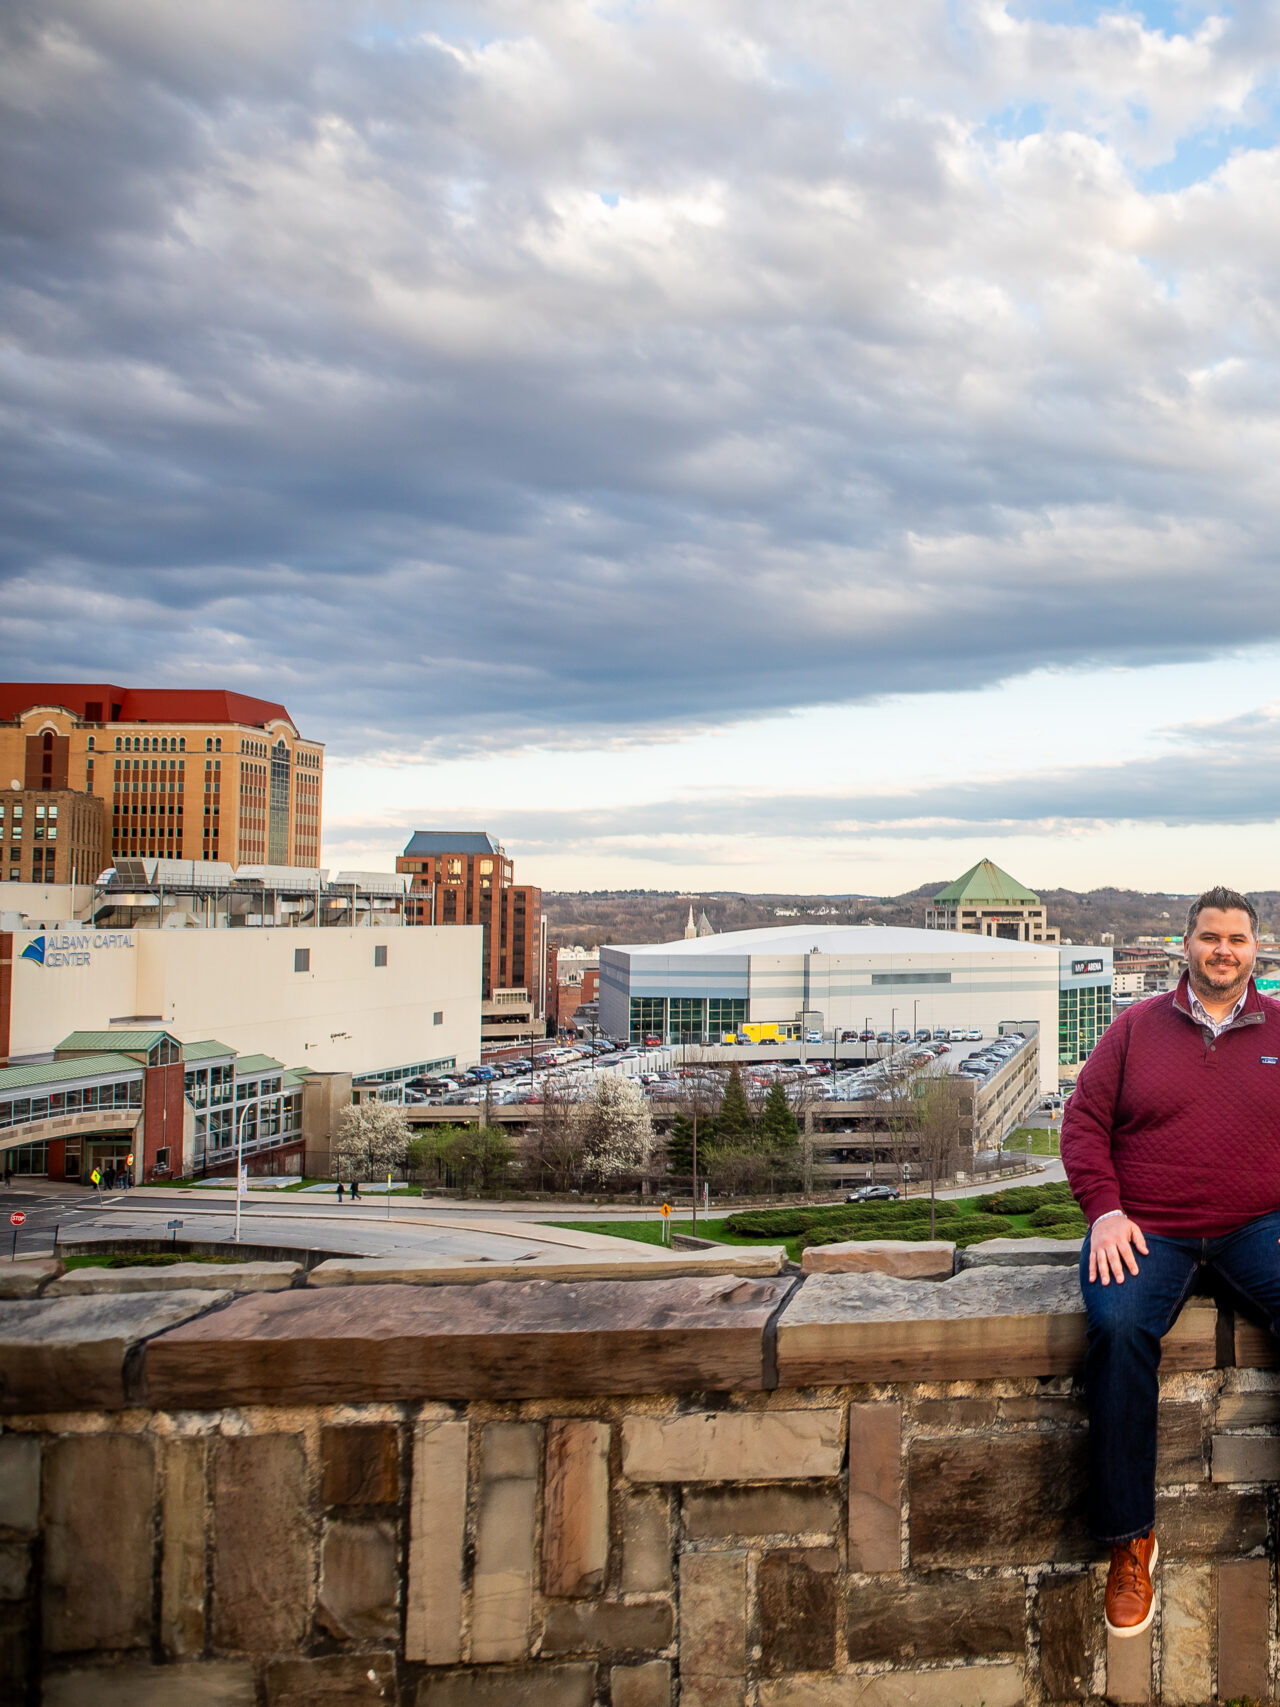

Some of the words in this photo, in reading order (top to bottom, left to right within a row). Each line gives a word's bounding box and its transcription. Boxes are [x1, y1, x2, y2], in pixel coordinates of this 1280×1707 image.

[48, 935, 92, 949] ALBANY
[94, 934, 135, 948] CAPITAL
[46, 952, 91, 967] CENTER
